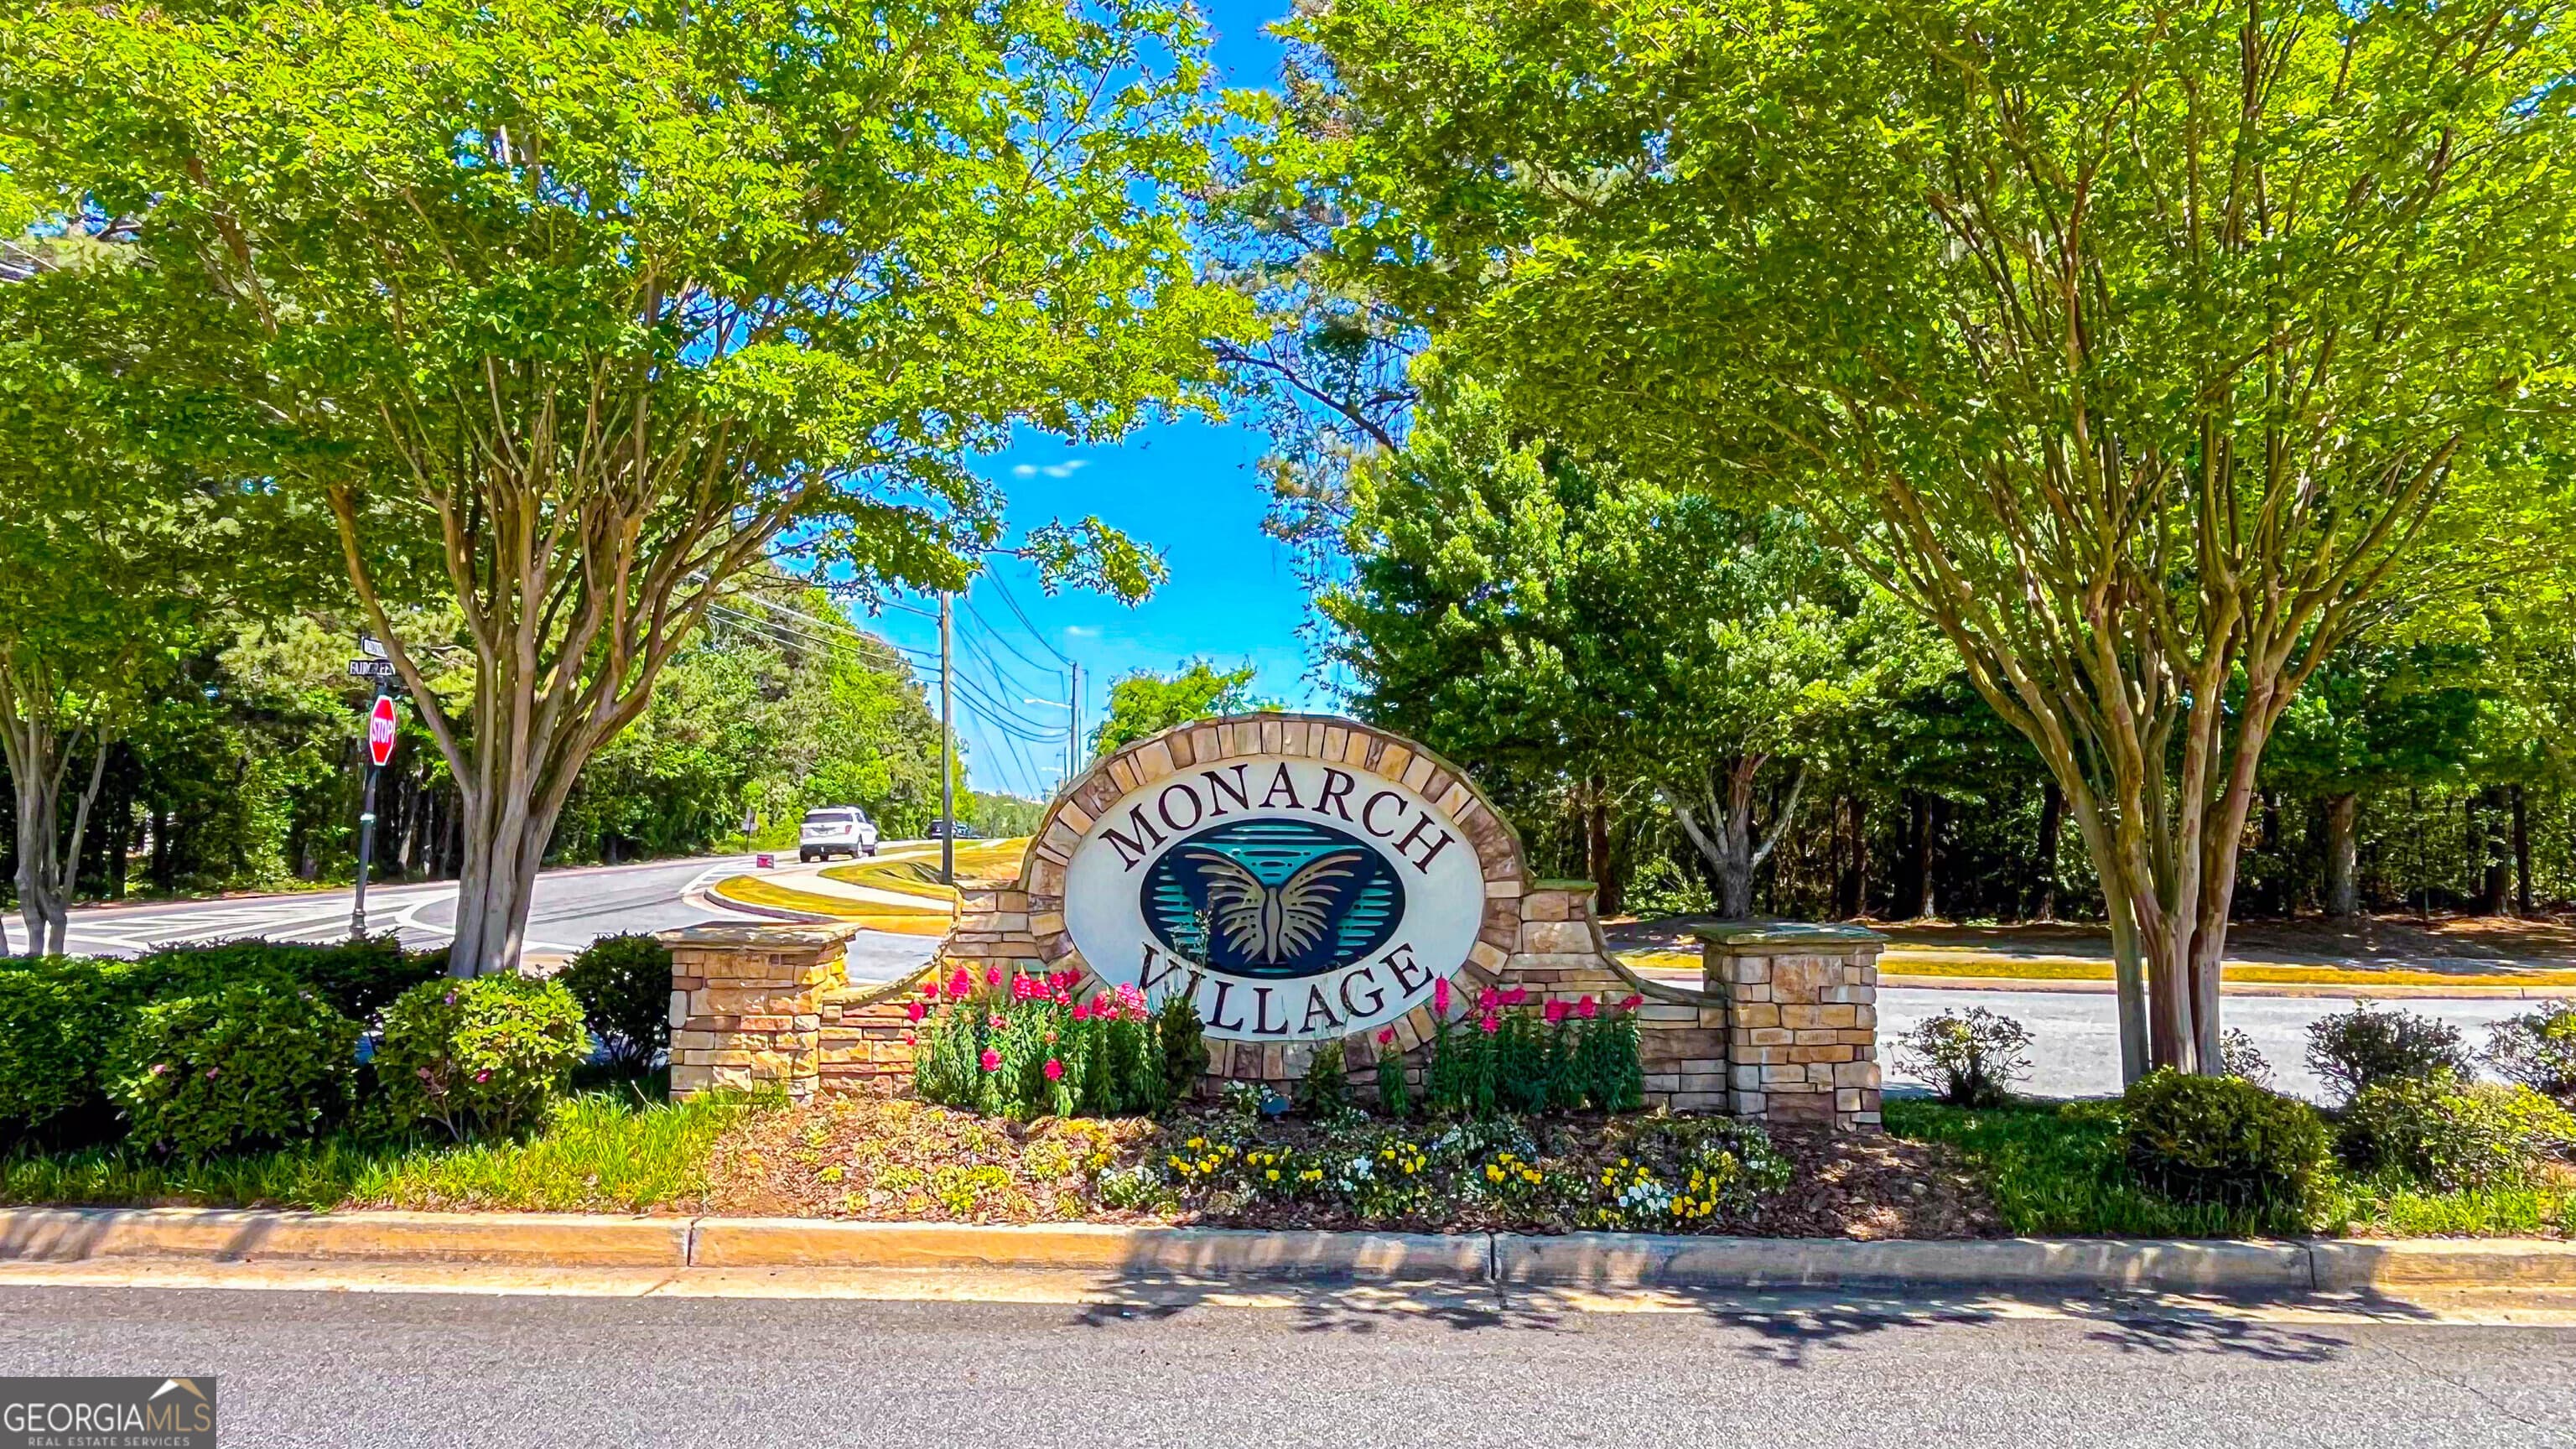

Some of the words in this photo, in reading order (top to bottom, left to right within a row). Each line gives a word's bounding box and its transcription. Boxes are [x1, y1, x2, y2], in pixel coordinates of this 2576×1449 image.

[372, 717, 392, 744] STOP
[1098, 761, 1455, 875] MONARCH
[1138, 941, 1433, 1035] VILLAGE
